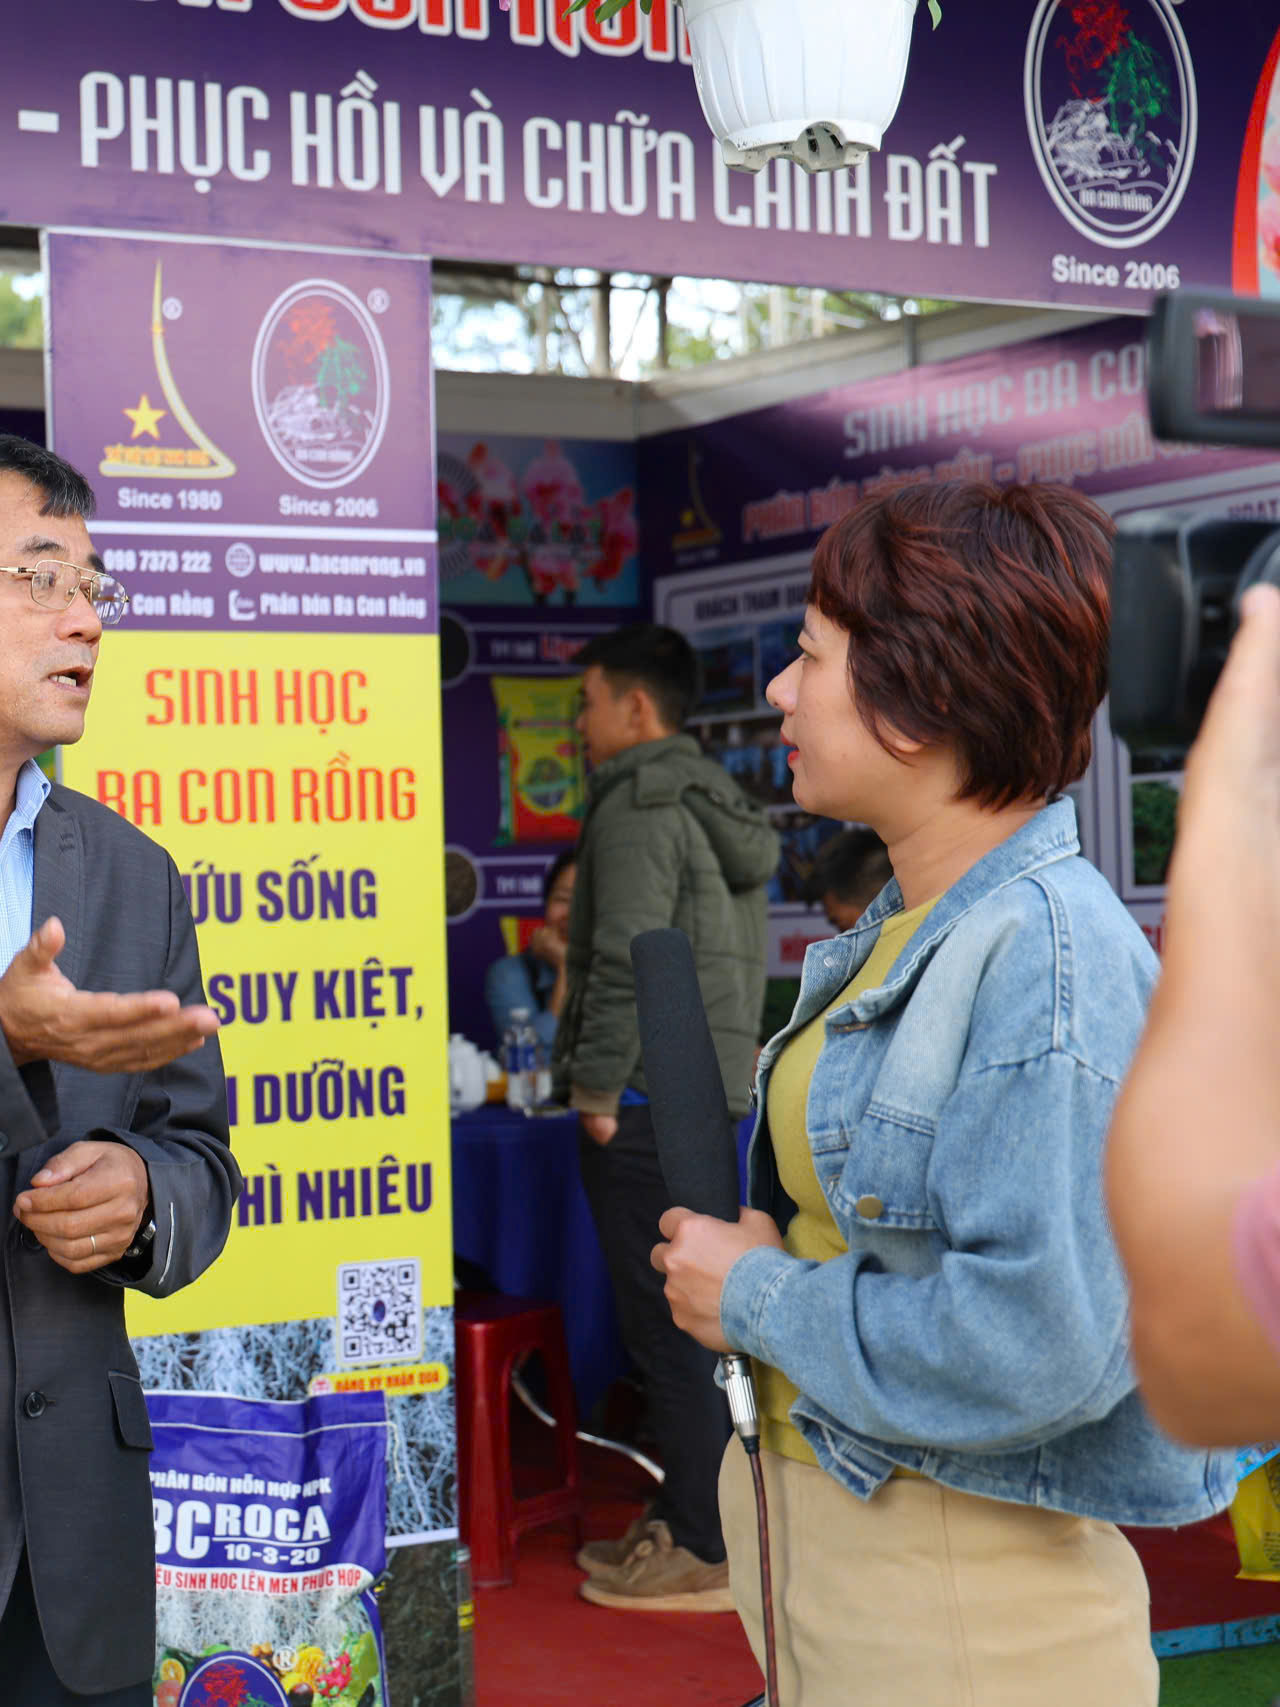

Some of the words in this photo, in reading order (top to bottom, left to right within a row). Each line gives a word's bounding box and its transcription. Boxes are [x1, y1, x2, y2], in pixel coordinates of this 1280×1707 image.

[79, 71, 270, 194] PHỤC
[291, 69, 401, 194] HỒI
[420, 87, 505, 204] VÀ
[523, 109, 696, 221] CHỮA
[884, 135, 997, 248] ĐẤT
[1052, 254, 1119, 287] Since
[1124, 261, 1181, 289] 2006
[844, 396, 927, 459] SINH
[937, 374, 1013, 437] HỌC
[1024, 360, 1078, 417] BA
[1090, 342, 1149, 401] CO
[118, 486, 173, 509] Since
[177, 489, 223, 511] 1980
[279, 494, 331, 517] Since
[145, 669, 258, 726] SINH
[274, 669, 368, 735] HỌC
[97, 769, 162, 827] BA
[178, 768, 276, 825] CON
[292, 750, 417, 825] RỒNG
[180, 859, 242, 924] ỨU
[257, 853, 378, 923] SỐNG
[208, 971, 298, 1026] SUY
[313, 956, 424, 1029] KIỆT,
[253, 1057, 406, 1125] DƯỠNG
[237, 1163, 283, 1228] HÌ
[297, 1154, 433, 1222] NHIÊU
[192, 1473, 228, 1493] BÓN
[230, 1473, 265, 1496] HỖN
[267, 1479, 302, 1501] HỢP
[302, 1477, 332, 1498] NPK
[214, 1503, 331, 1543] ROCA
[224, 1543, 321, 1566] 10-3-20
[175, 1571, 207, 1589] SINH
[241, 1570, 265, 1592] LÊN
[269, 1577, 298, 1594] MEN
